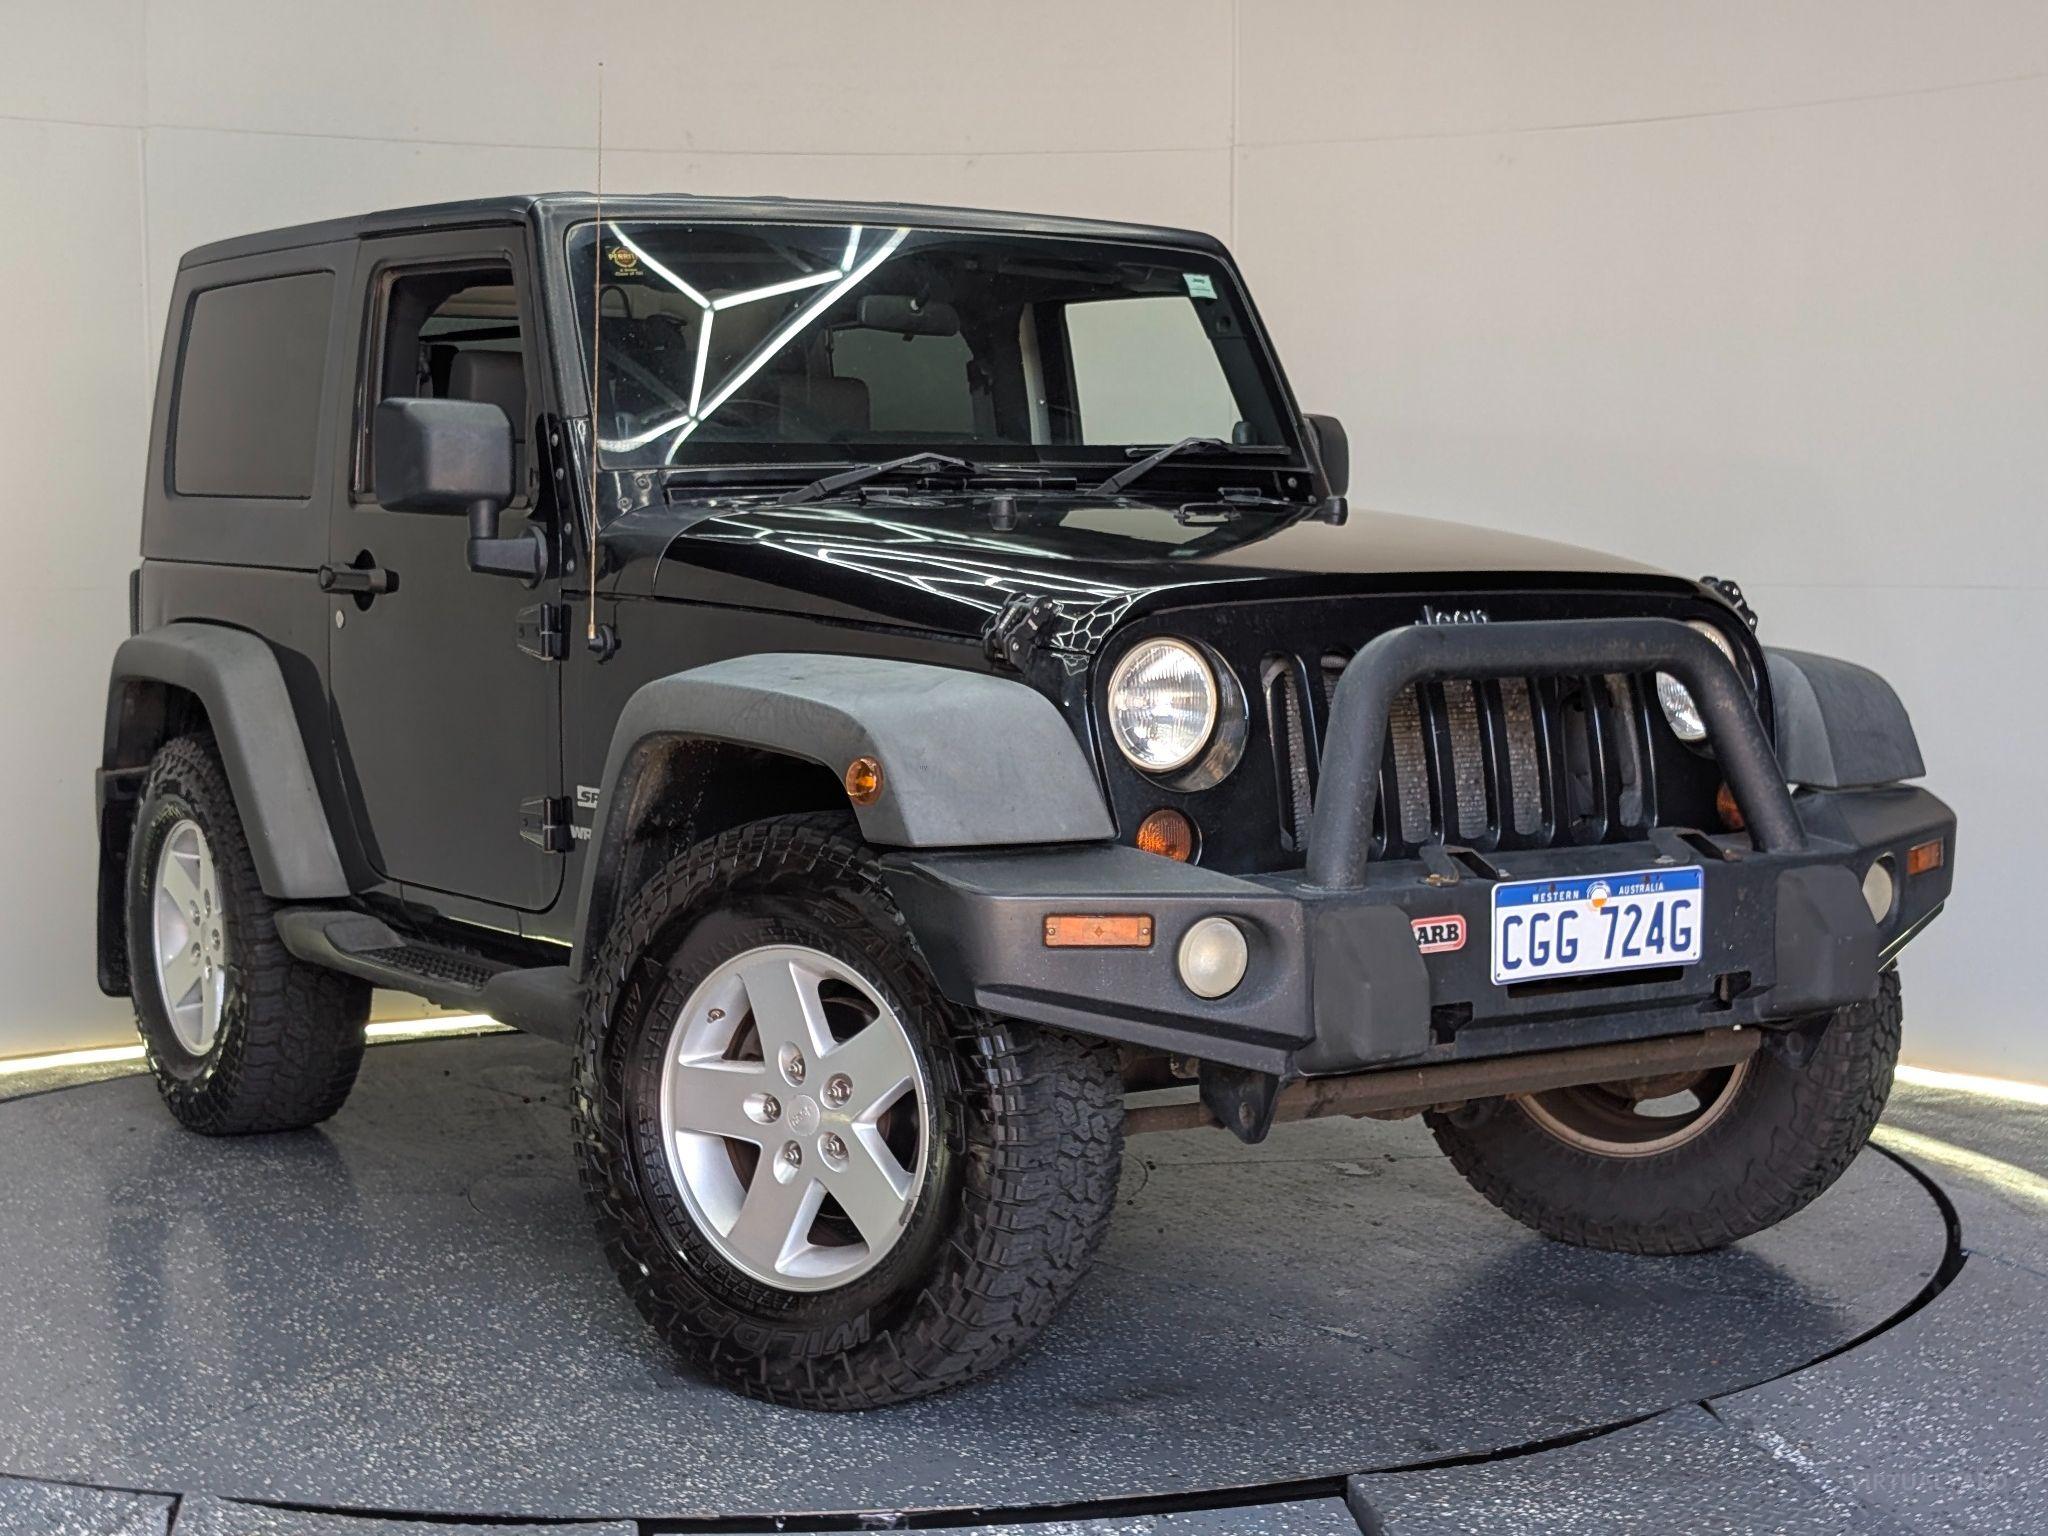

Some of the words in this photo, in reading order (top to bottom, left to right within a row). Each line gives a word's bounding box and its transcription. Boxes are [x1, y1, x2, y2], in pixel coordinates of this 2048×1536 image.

[1532, 889, 1580, 902] WESTERN
[1619, 882, 1665, 896] AUSTRALIA
[1417, 923, 1459, 944] ARB
[1503, 910, 1578, 970] CGG
[1600, 900, 1691, 959] 724G
